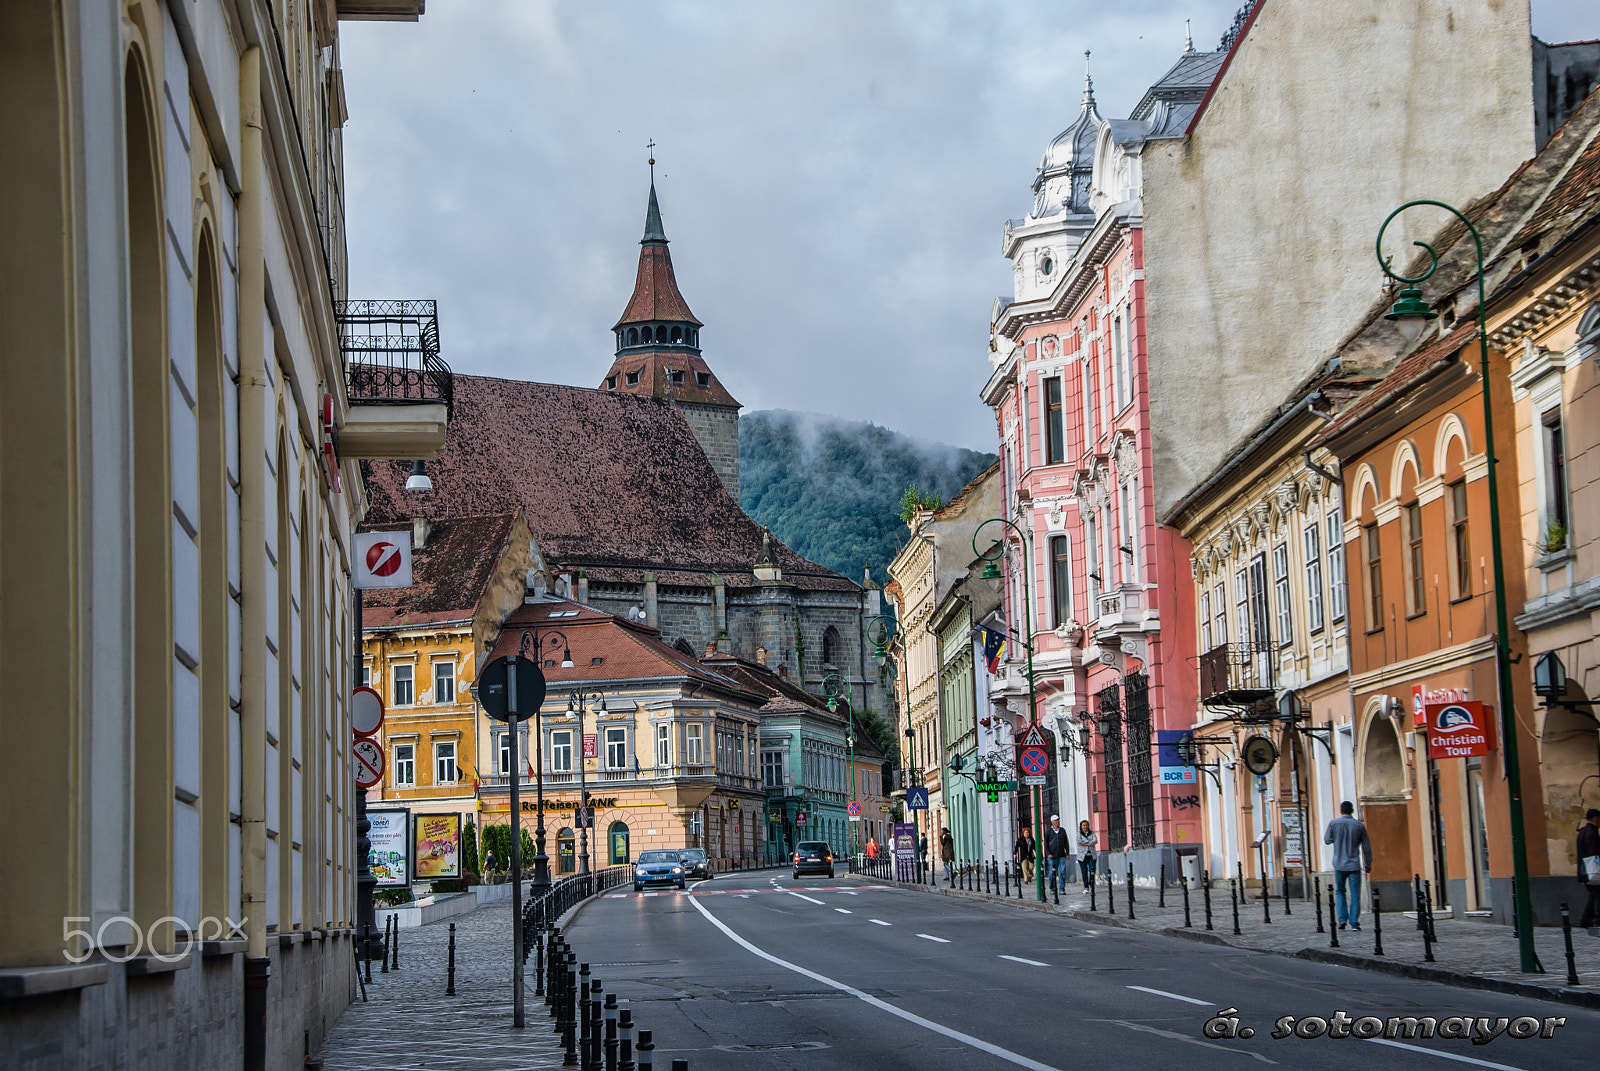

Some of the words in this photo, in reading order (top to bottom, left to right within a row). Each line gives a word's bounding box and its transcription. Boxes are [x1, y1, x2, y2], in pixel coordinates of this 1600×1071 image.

[1431, 734, 1485, 747] Christian
[1445, 747, 1472, 756] Tour
[1164, 772, 1183, 780] BCR
[522, 799, 580, 811] Raffeisen
